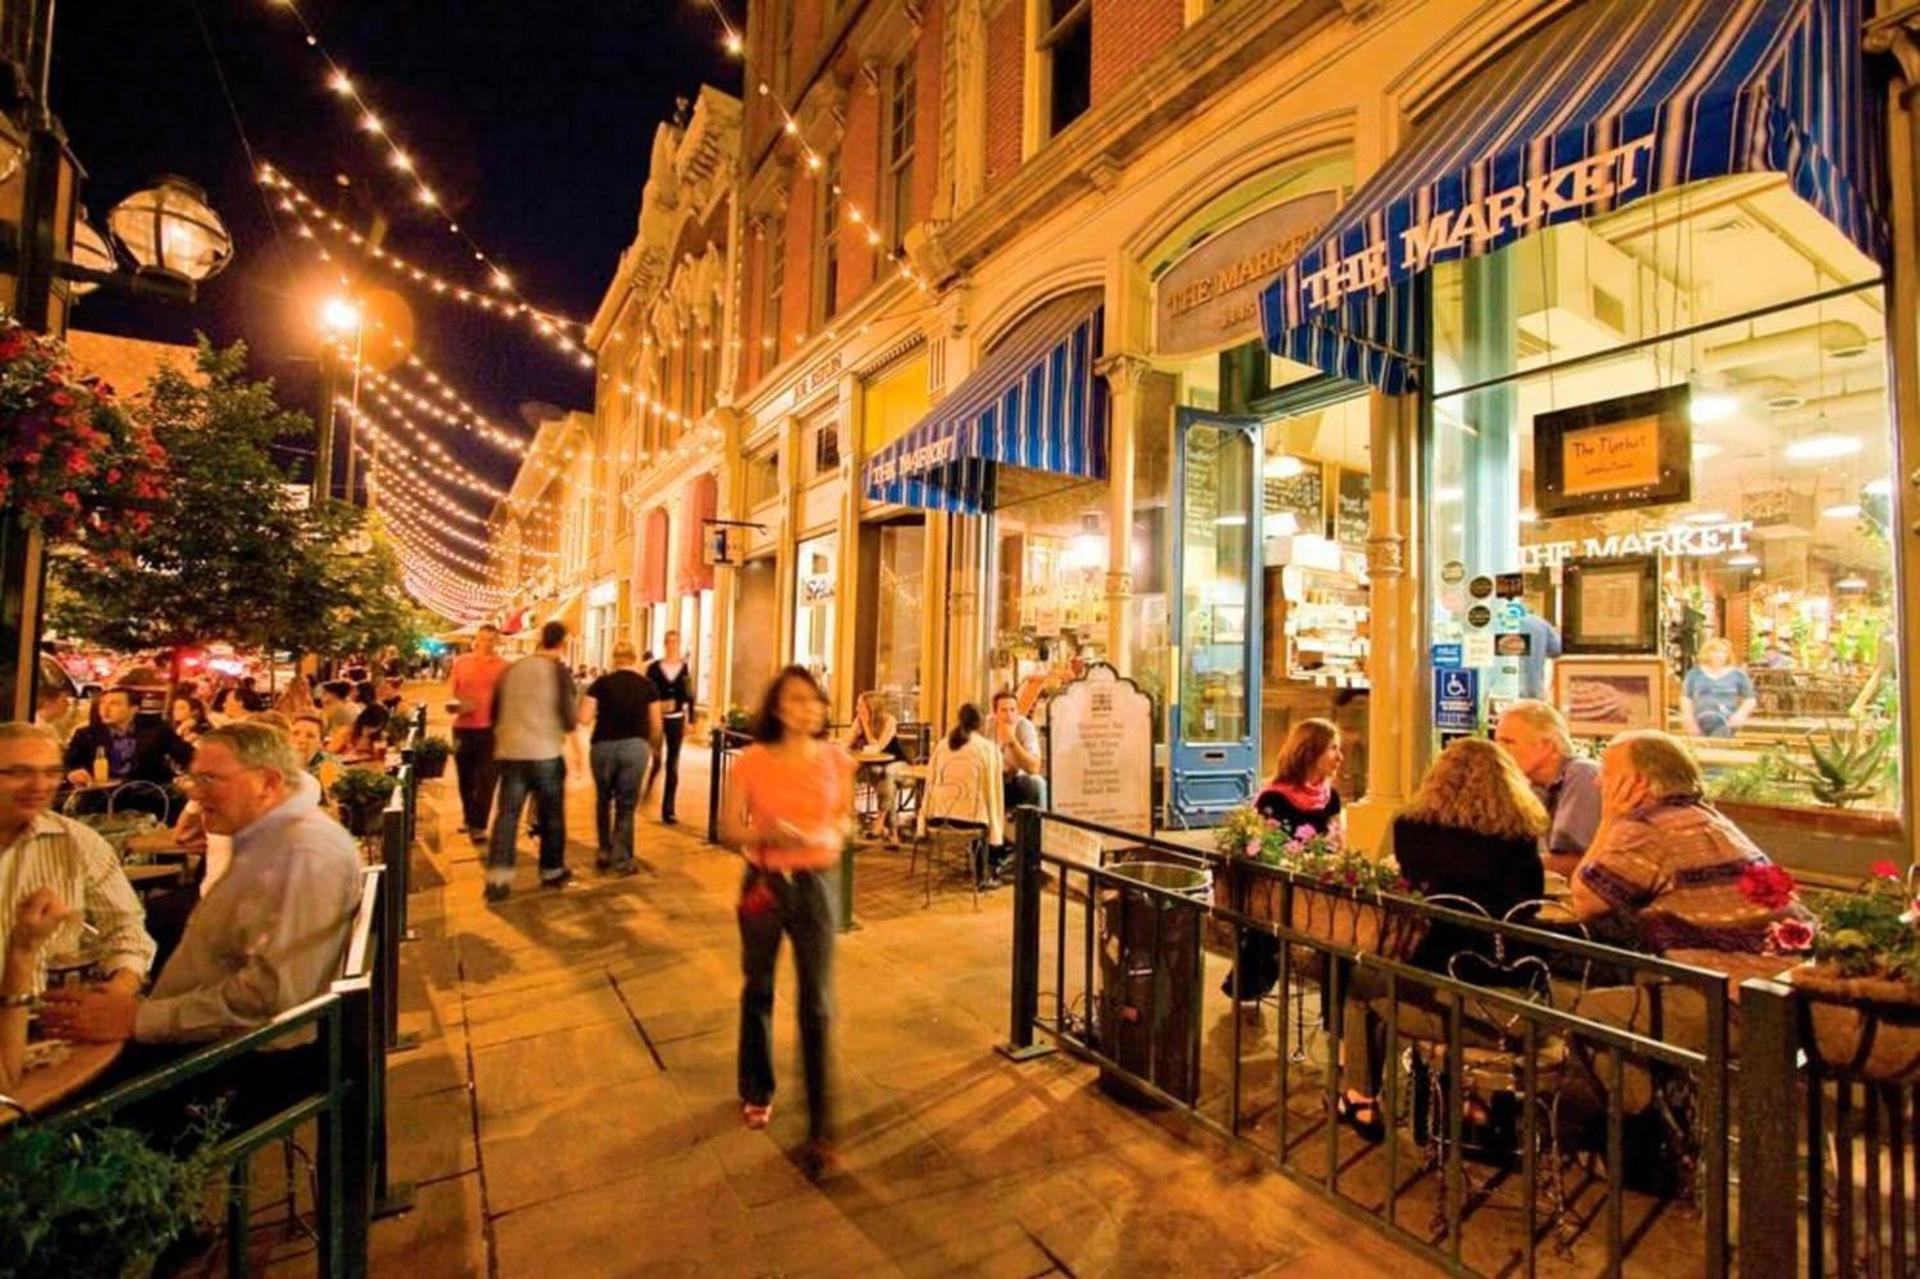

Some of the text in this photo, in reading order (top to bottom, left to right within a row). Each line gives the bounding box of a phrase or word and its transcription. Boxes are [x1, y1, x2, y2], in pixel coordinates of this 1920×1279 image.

[1302, 133, 1656, 309] THE MARKET
[1168, 278, 1212, 307] THE
[1583, 521, 1754, 558] MARKET
